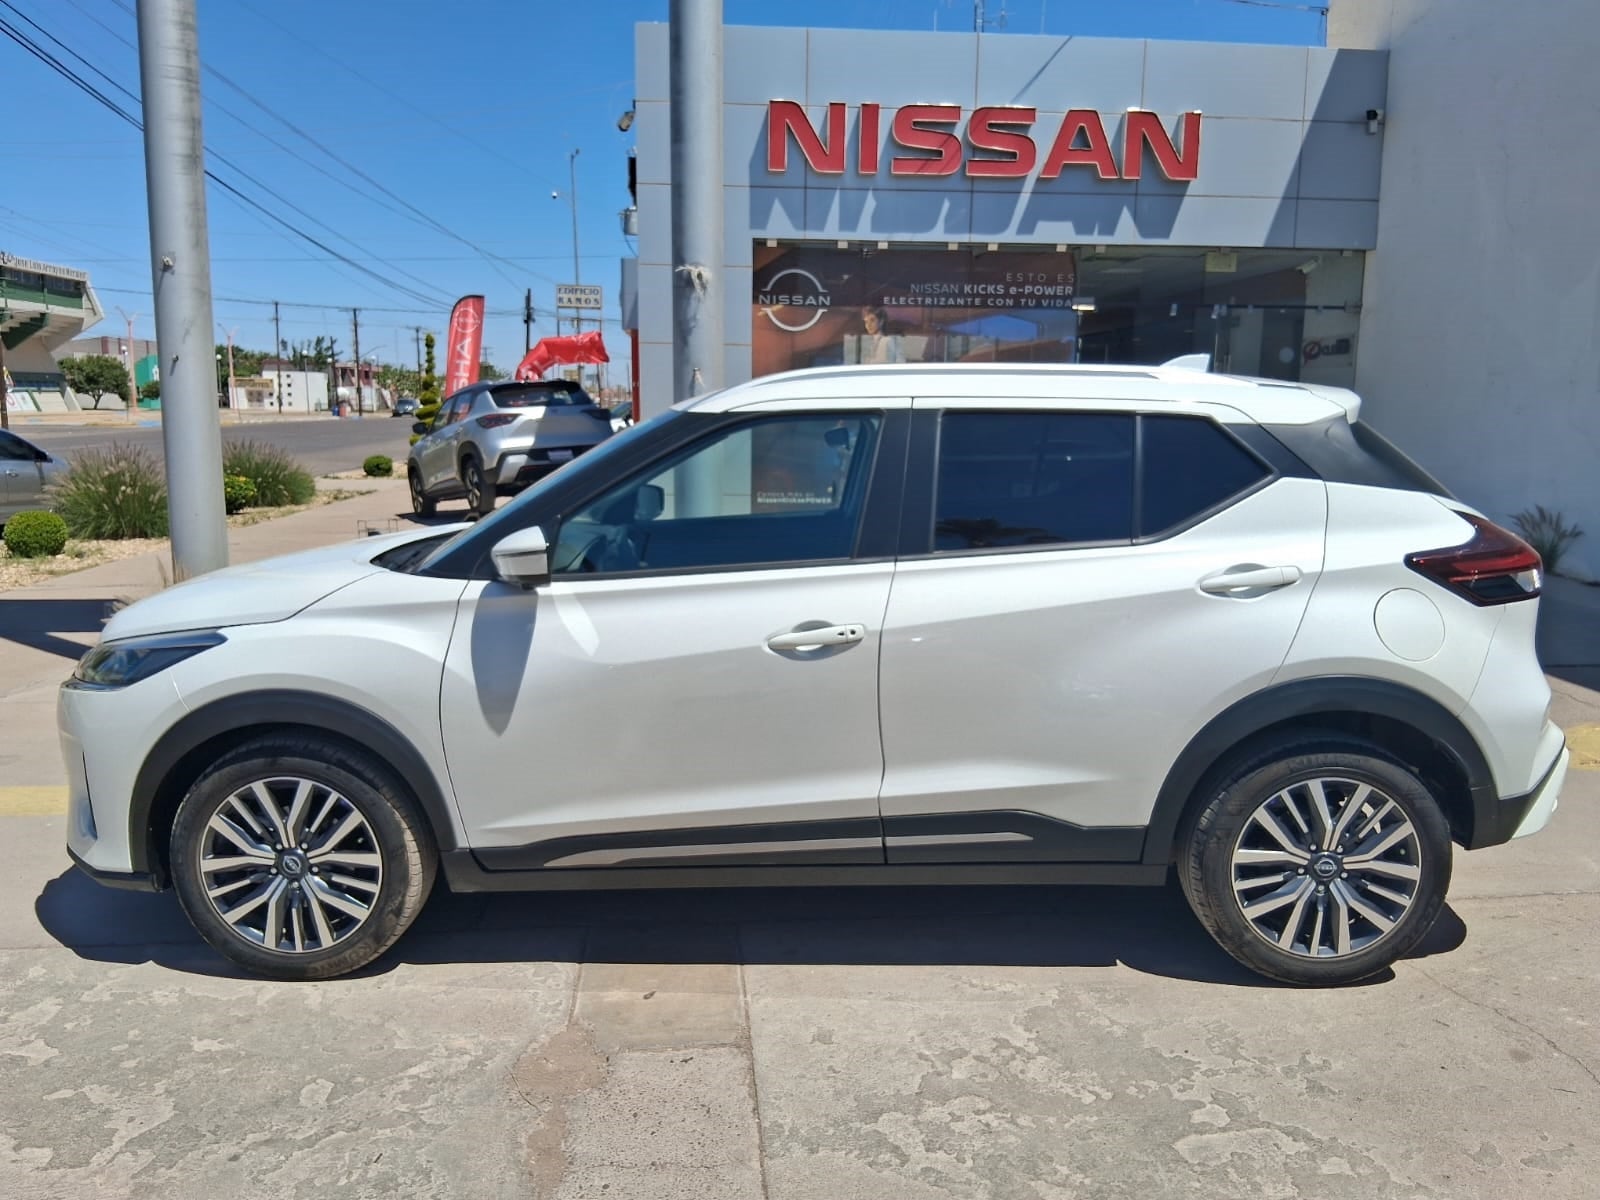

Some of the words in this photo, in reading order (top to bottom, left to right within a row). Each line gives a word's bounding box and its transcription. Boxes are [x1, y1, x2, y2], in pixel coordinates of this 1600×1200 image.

[767, 98, 1202, 181] NISSAN
[1006, 272, 1047, 283] ESTO
[1057, 273, 1075, 283] ES
[910, 283, 959, 294] NISSAN
[963, 284, 1005, 295] KICKS
[1009, 284, 1073, 296] e-POWER
[759, 294, 831, 306] NISSAN
[883, 296, 983, 306] ELECTRIZANTE
[987, 297, 1014, 307] CON
[1020, 298, 1036, 307] TU
[1041, 299, 1073, 308] VIDA
